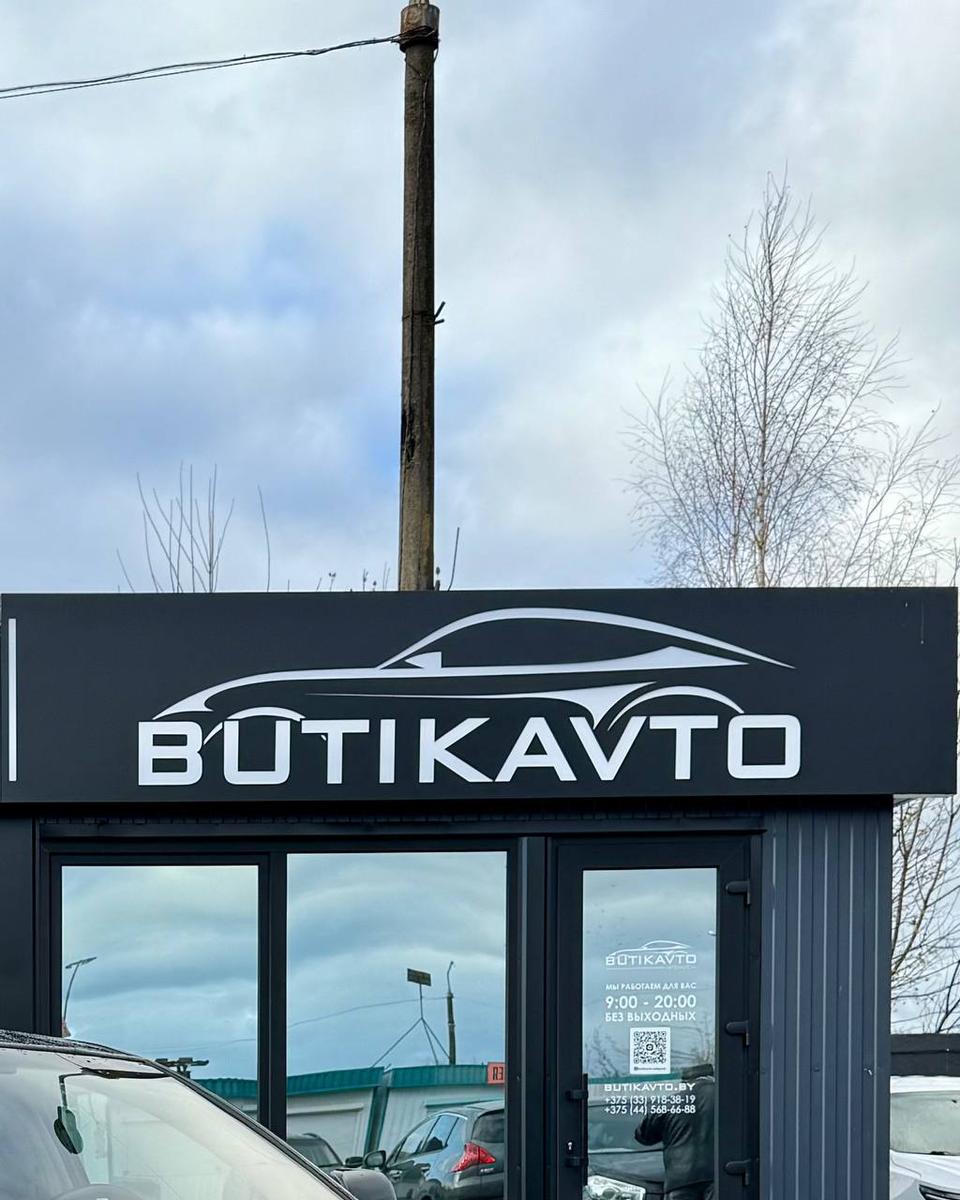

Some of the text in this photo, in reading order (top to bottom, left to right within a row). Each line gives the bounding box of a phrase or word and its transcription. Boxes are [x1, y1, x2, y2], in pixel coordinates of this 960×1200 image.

[138, 714, 801, 786] BUTIKAVTO
[605, 954, 697, 966] BUTIKAVTO
[663, 982, 679, 990] ДЛЯ
[605, 995, 638, 1009] 9:00
[654, 994, 697, 1008] 20:00
[605, 1011, 696, 1022] БЕЗ ВЫХОДНЫХ
[604, 1083, 696, 1092] BUTIKAVTO.BY
[604, 1095, 696, 1106] +375 (33) 918-38-19
[604, 1105, 696, 1115] +375 (44) 568-66-88
